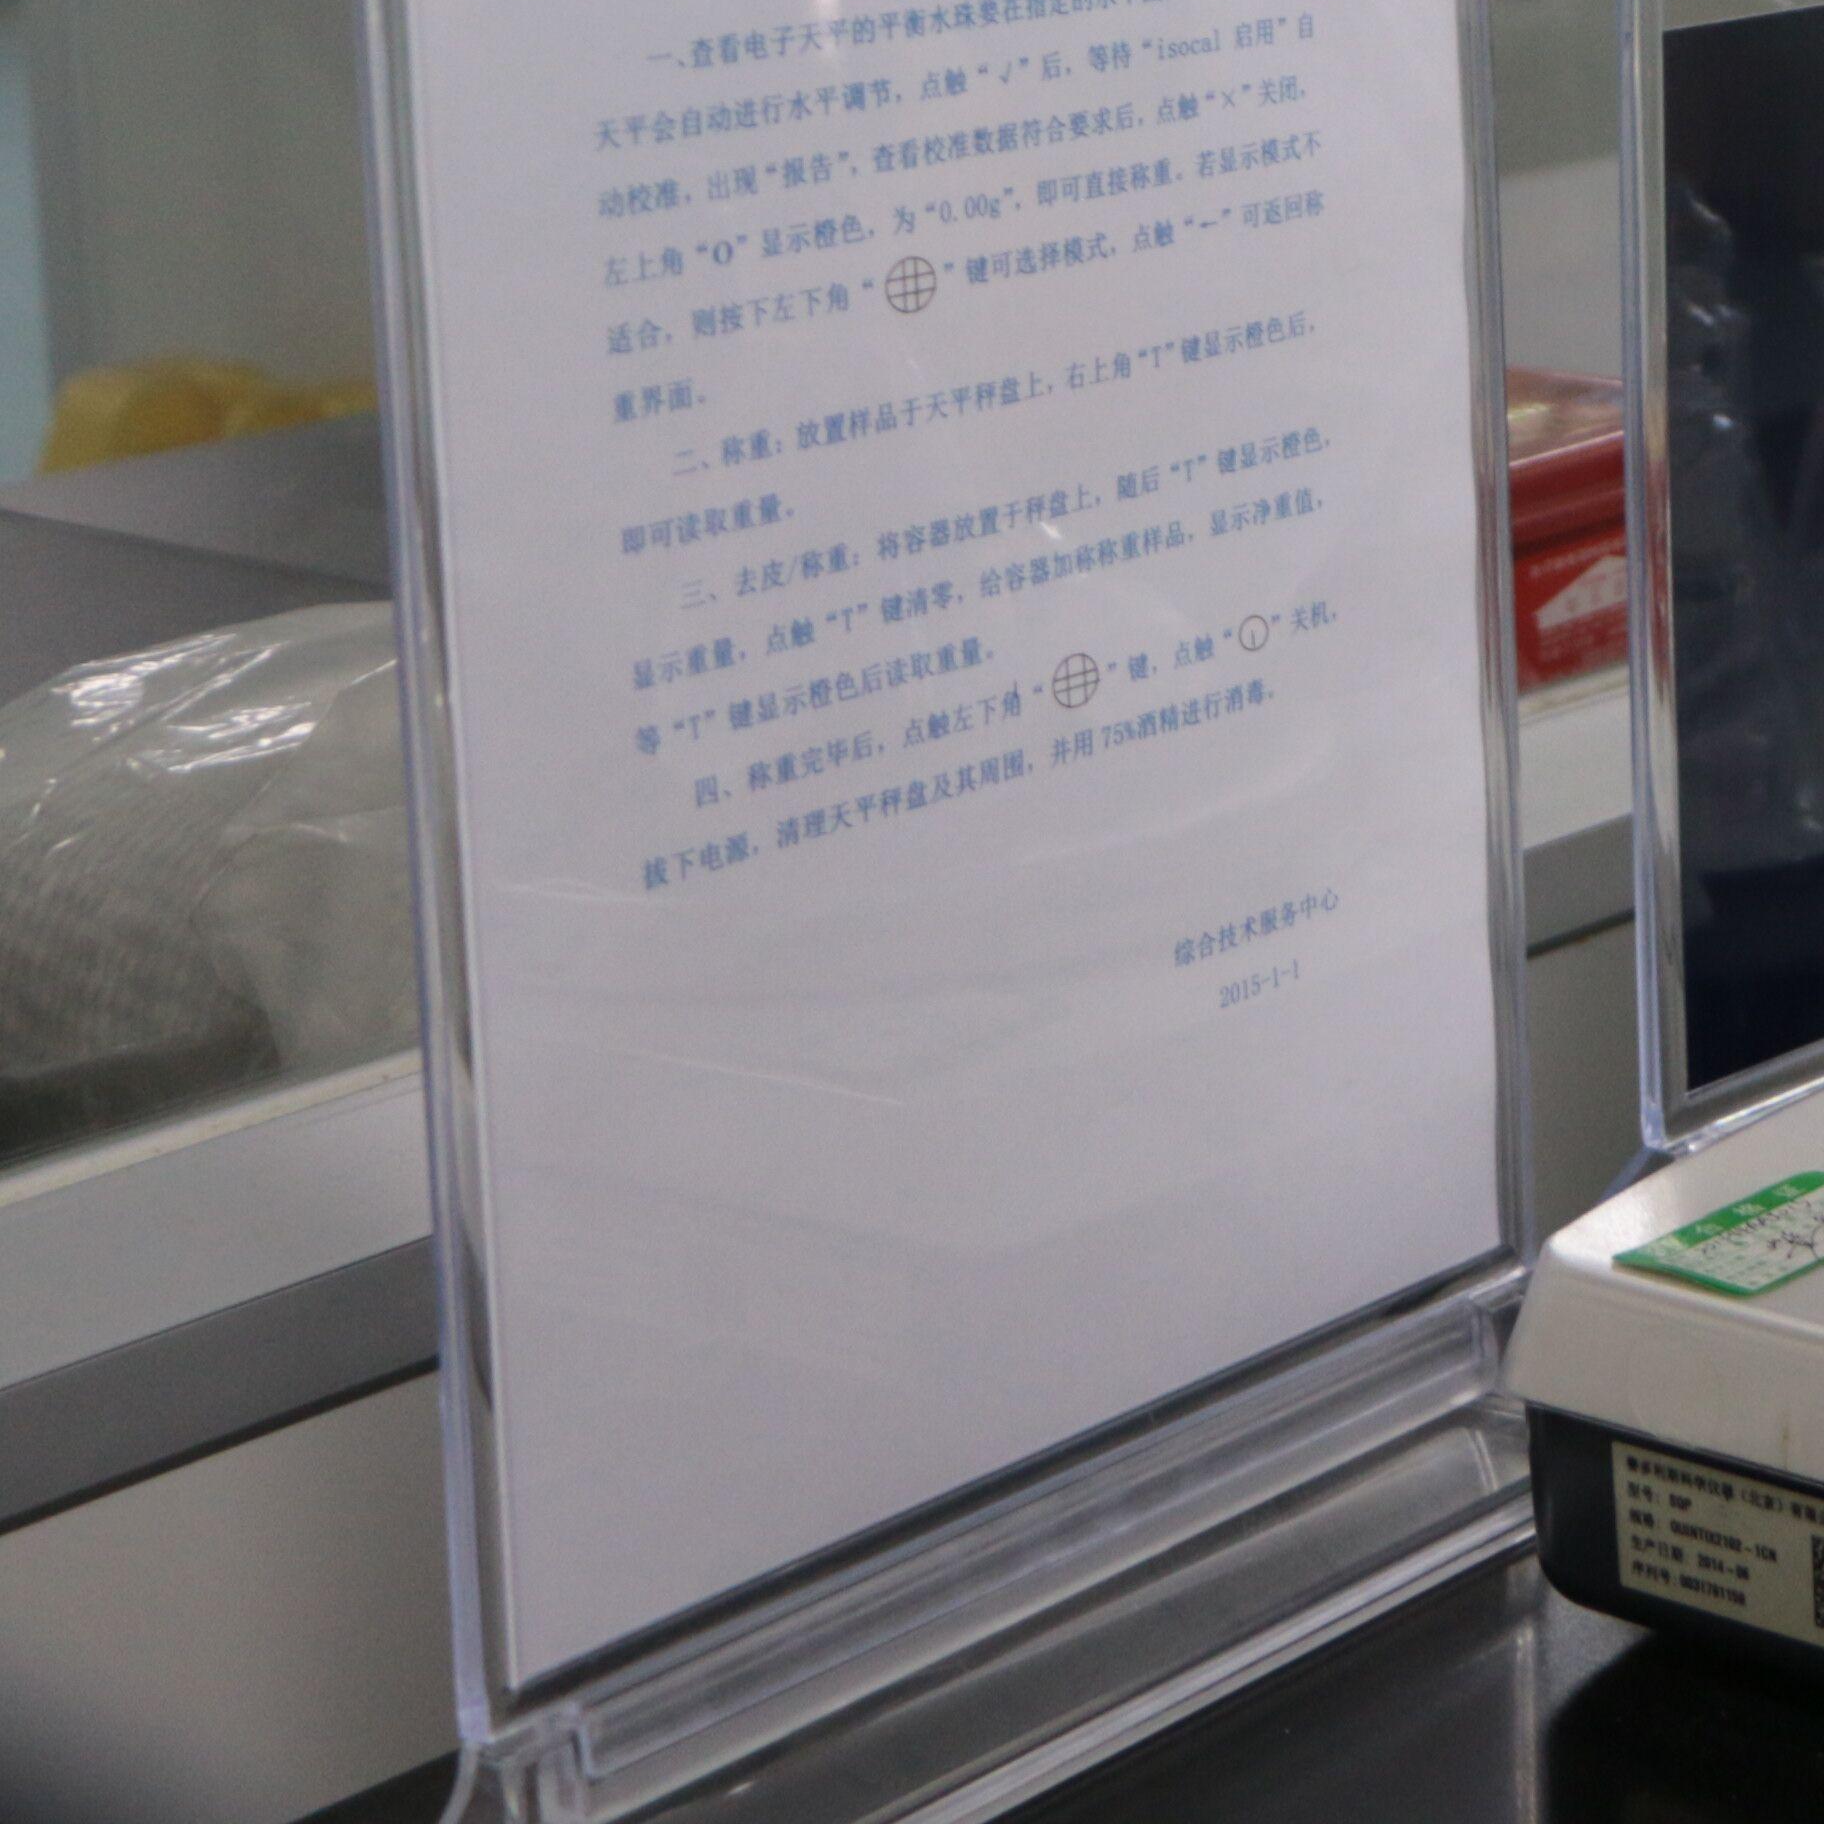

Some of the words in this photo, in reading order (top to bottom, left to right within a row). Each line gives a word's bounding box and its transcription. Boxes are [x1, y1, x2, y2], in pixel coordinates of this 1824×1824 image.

[1173, 885, 1341, 971] 综合技术服务中心
